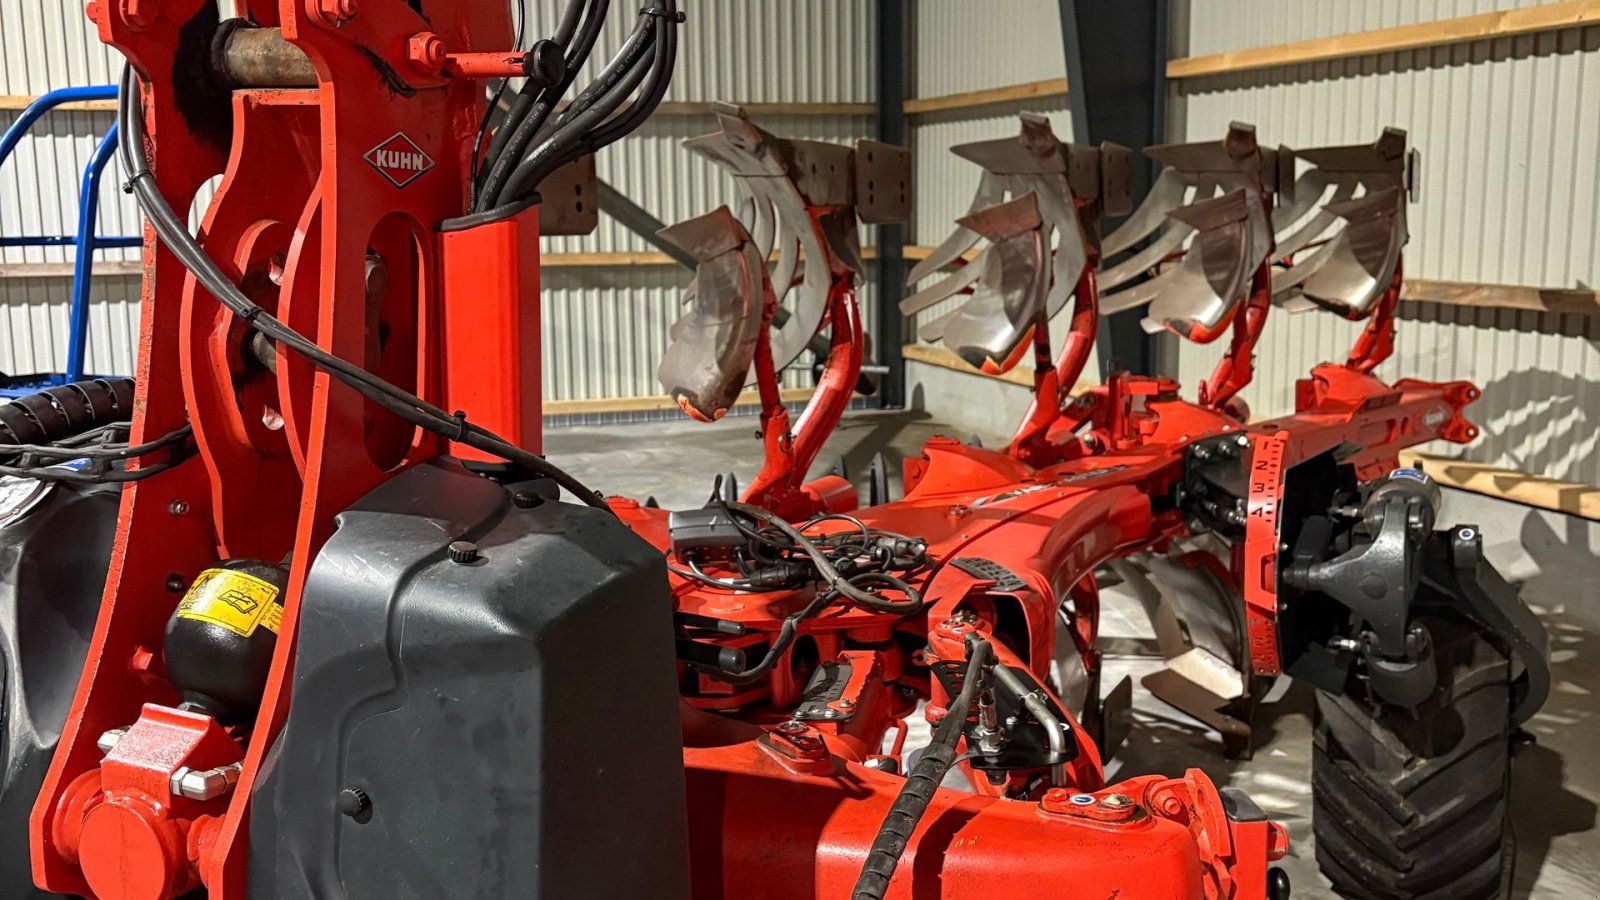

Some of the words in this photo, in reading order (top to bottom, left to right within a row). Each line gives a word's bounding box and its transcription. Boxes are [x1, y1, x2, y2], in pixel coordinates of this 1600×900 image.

[376, 149, 423, 170] KUHN
[1256, 461, 1268, 470] 2
[1253, 483, 1265, 493] 3
[1251, 507, 1263, 517] 4
